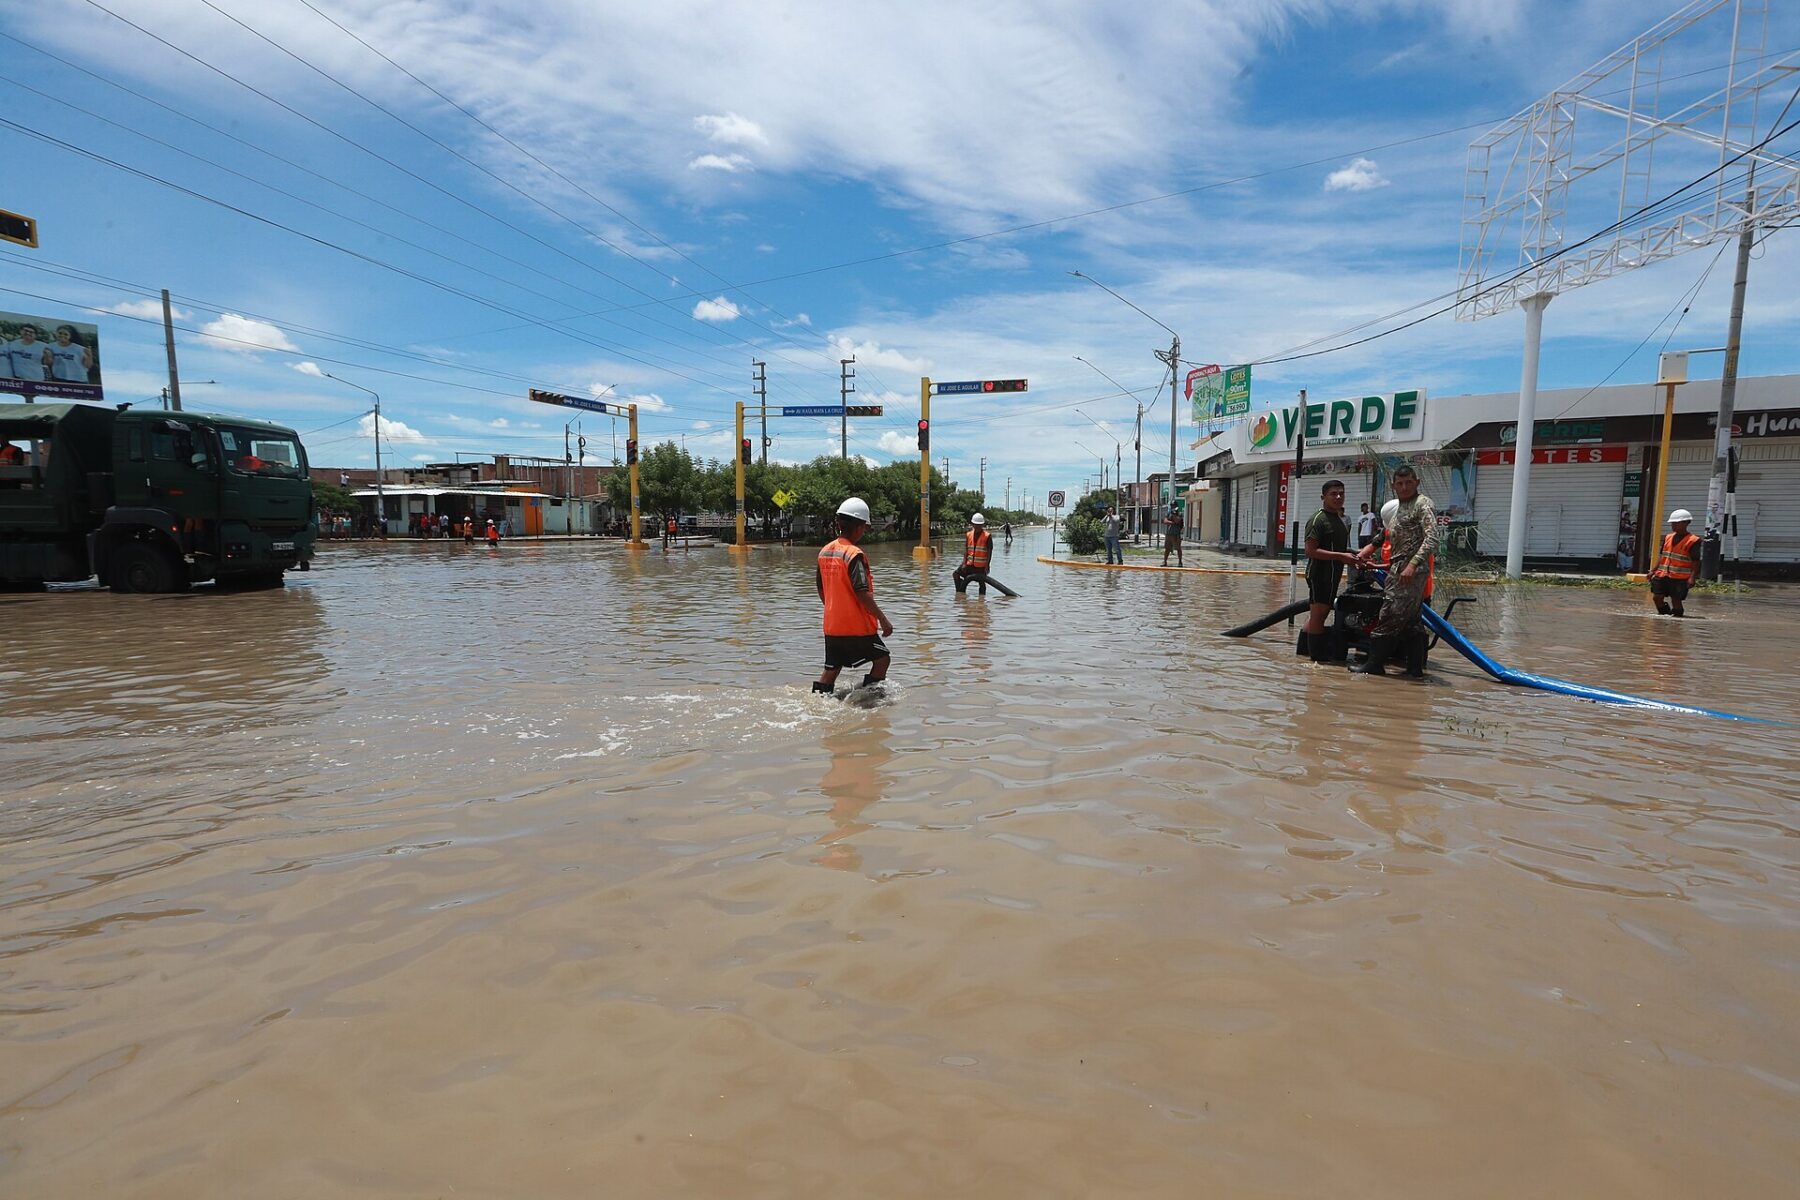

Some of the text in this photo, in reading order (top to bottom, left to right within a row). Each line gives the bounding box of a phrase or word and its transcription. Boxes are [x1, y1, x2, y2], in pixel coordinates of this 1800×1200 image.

[1283, 391, 1418, 449] VERDE
[1534, 422, 1603, 438] ERDE
[1501, 449, 1602, 465] LTES
[1279, 471, 1287, 534] LOTES
